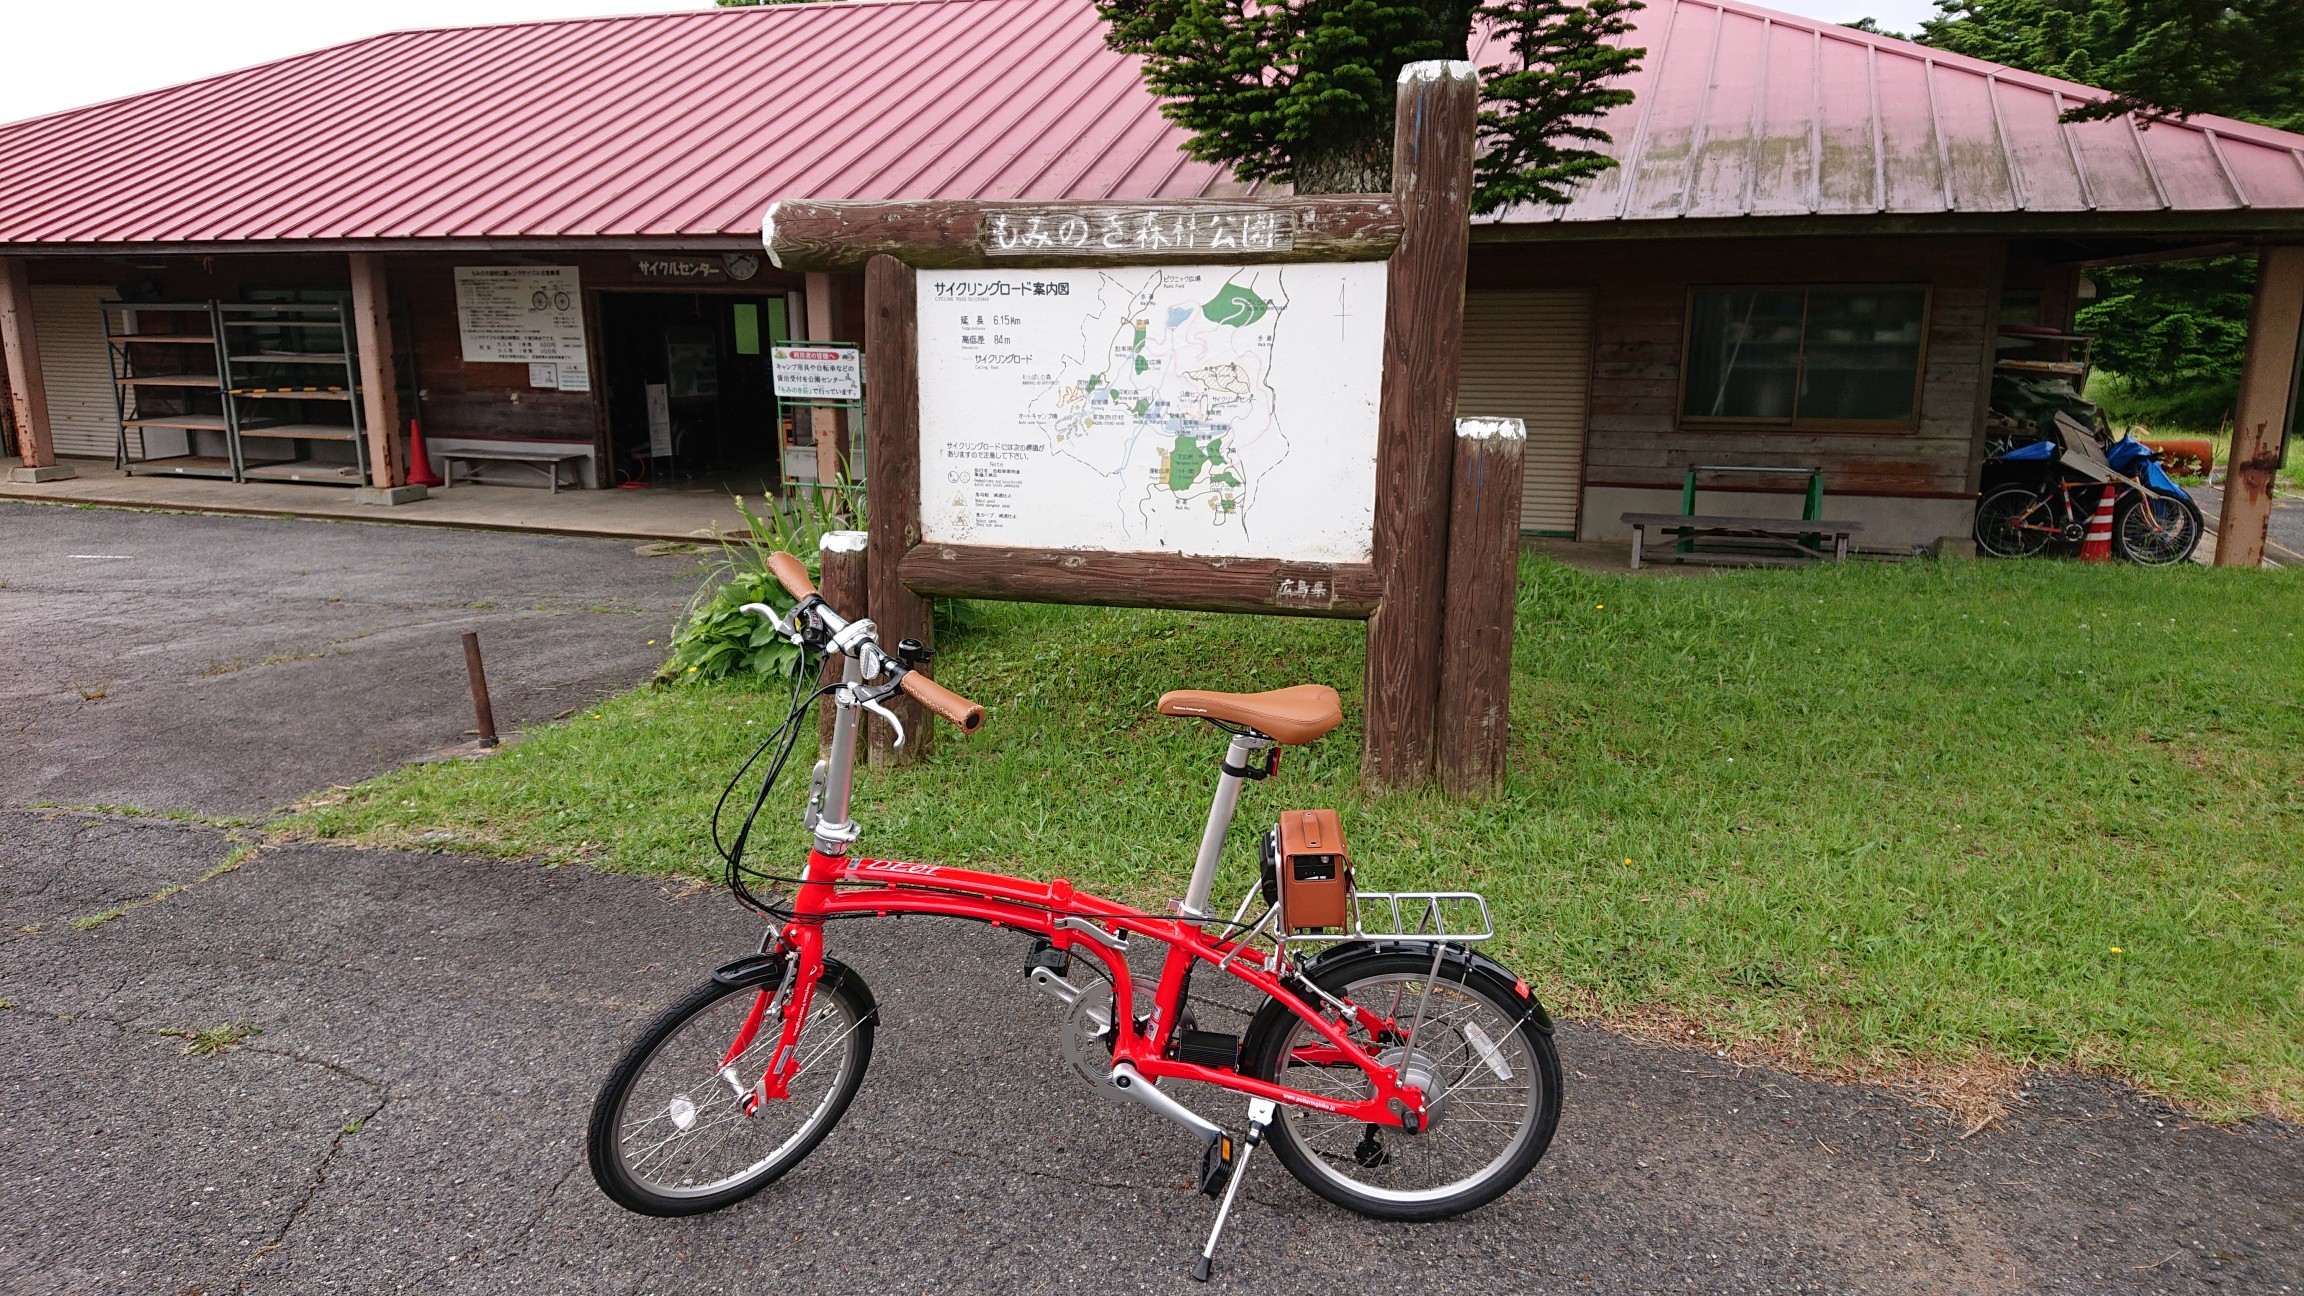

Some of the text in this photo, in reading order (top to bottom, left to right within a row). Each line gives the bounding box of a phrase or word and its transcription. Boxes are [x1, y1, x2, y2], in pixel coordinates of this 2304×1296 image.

[992, 210, 1275, 250] もみのき森林公園
[638, 260, 720, 277] サイクルセンター
[933, 280, 1070, 297] サイクリングロード案内図
[961, 335, 985, 345] 高低差
[792, 351, 836, 360] 利用者の皆様へ
[975, 353, 1033, 364] サイクリングロード
[776, 363, 855, 373] キャンプ用具や自転車などの
[777, 374, 845, 384] 貸出受付を公園センター
[1276, 578, 1328, 599] 広島県
[1282, 1093, 1336, 1111] www.potteringbike.jp
